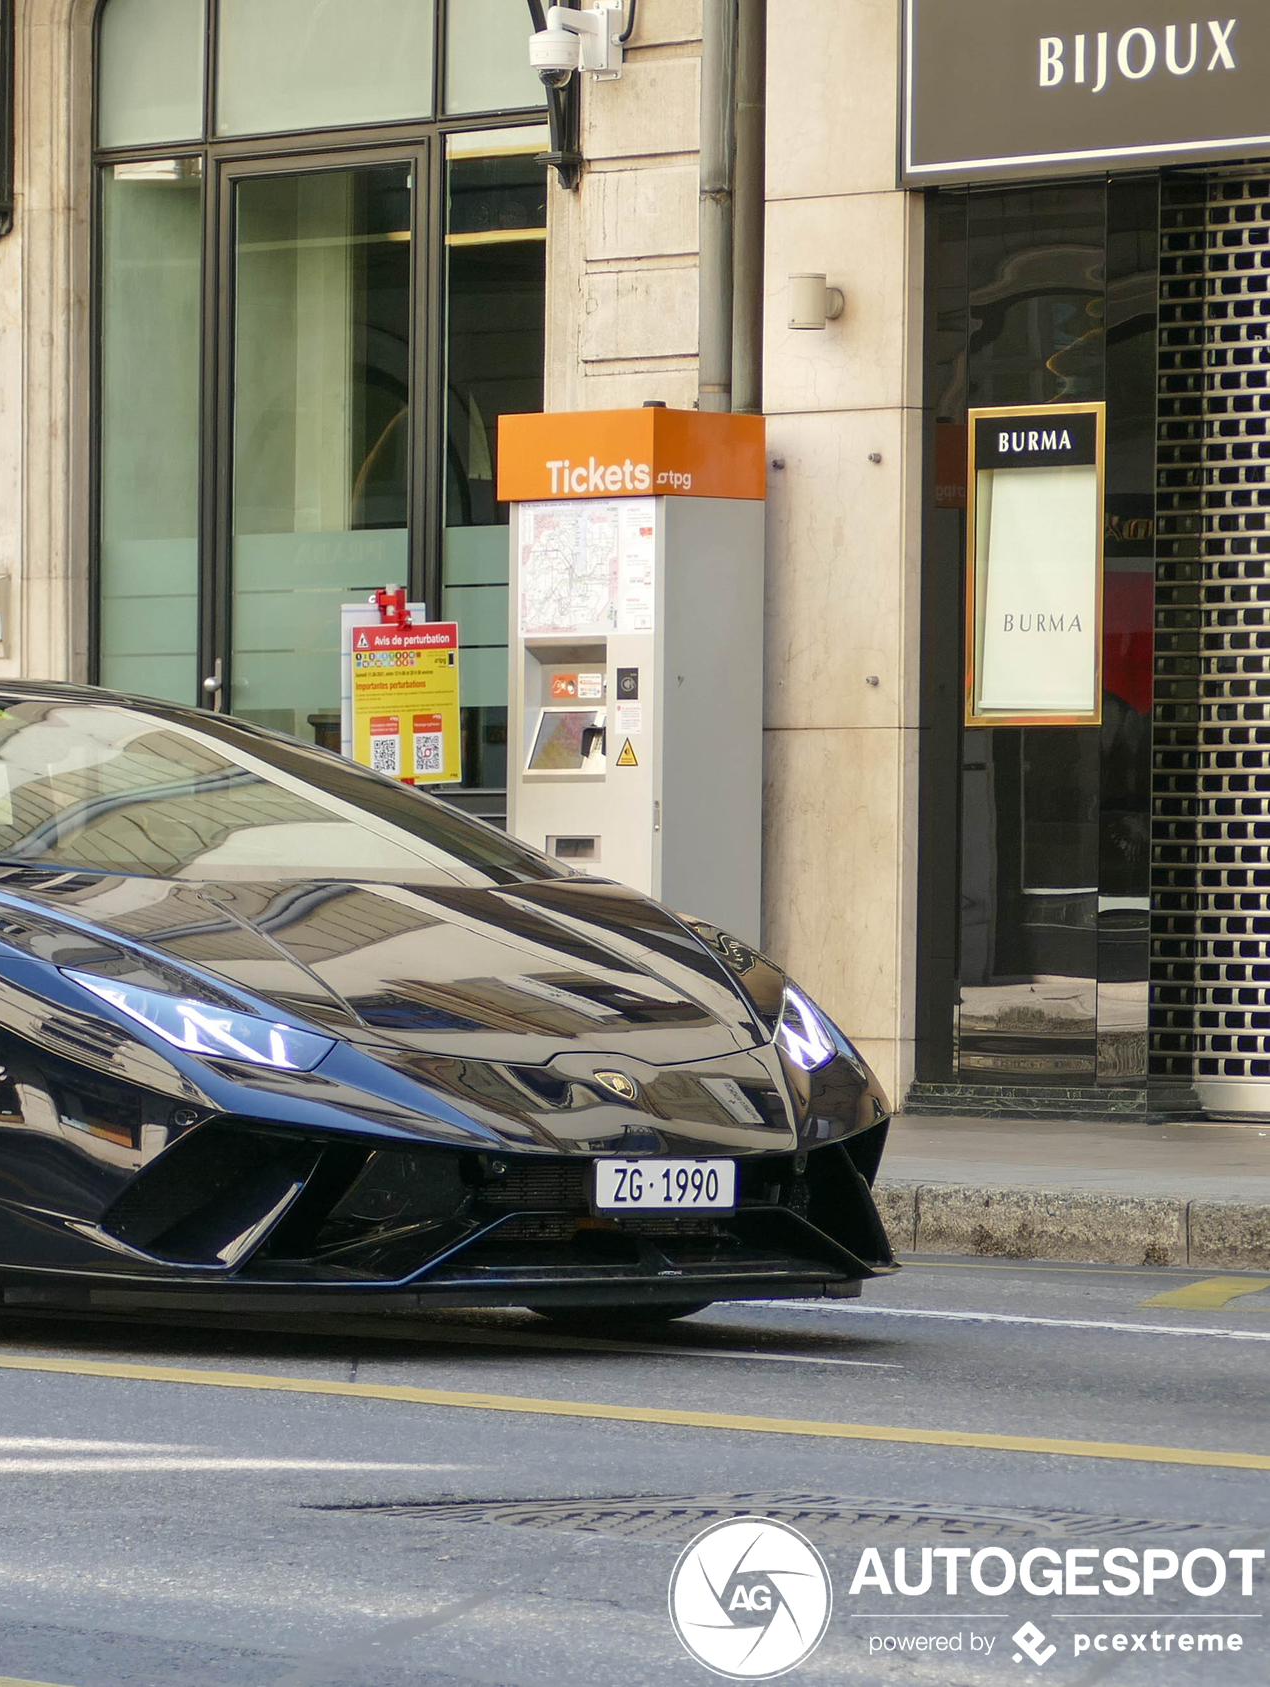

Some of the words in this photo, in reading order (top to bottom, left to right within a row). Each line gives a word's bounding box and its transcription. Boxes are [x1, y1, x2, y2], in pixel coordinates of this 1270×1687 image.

[1039, 19, 1237, 93] BIJOUX
[998, 429, 1072, 452] BURMA
[545, 456, 650, 494] Tickets
[668, 470, 691, 490] tpg
[1003, 613, 1082, 633] BURMA
[374, 635, 390, 646] Avis
[392, 634, 403, 645] de
[404, 634, 450, 647] perturbation
[356, 682, 388, 691] Importantes
[390, 681, 426, 690] perturbations
